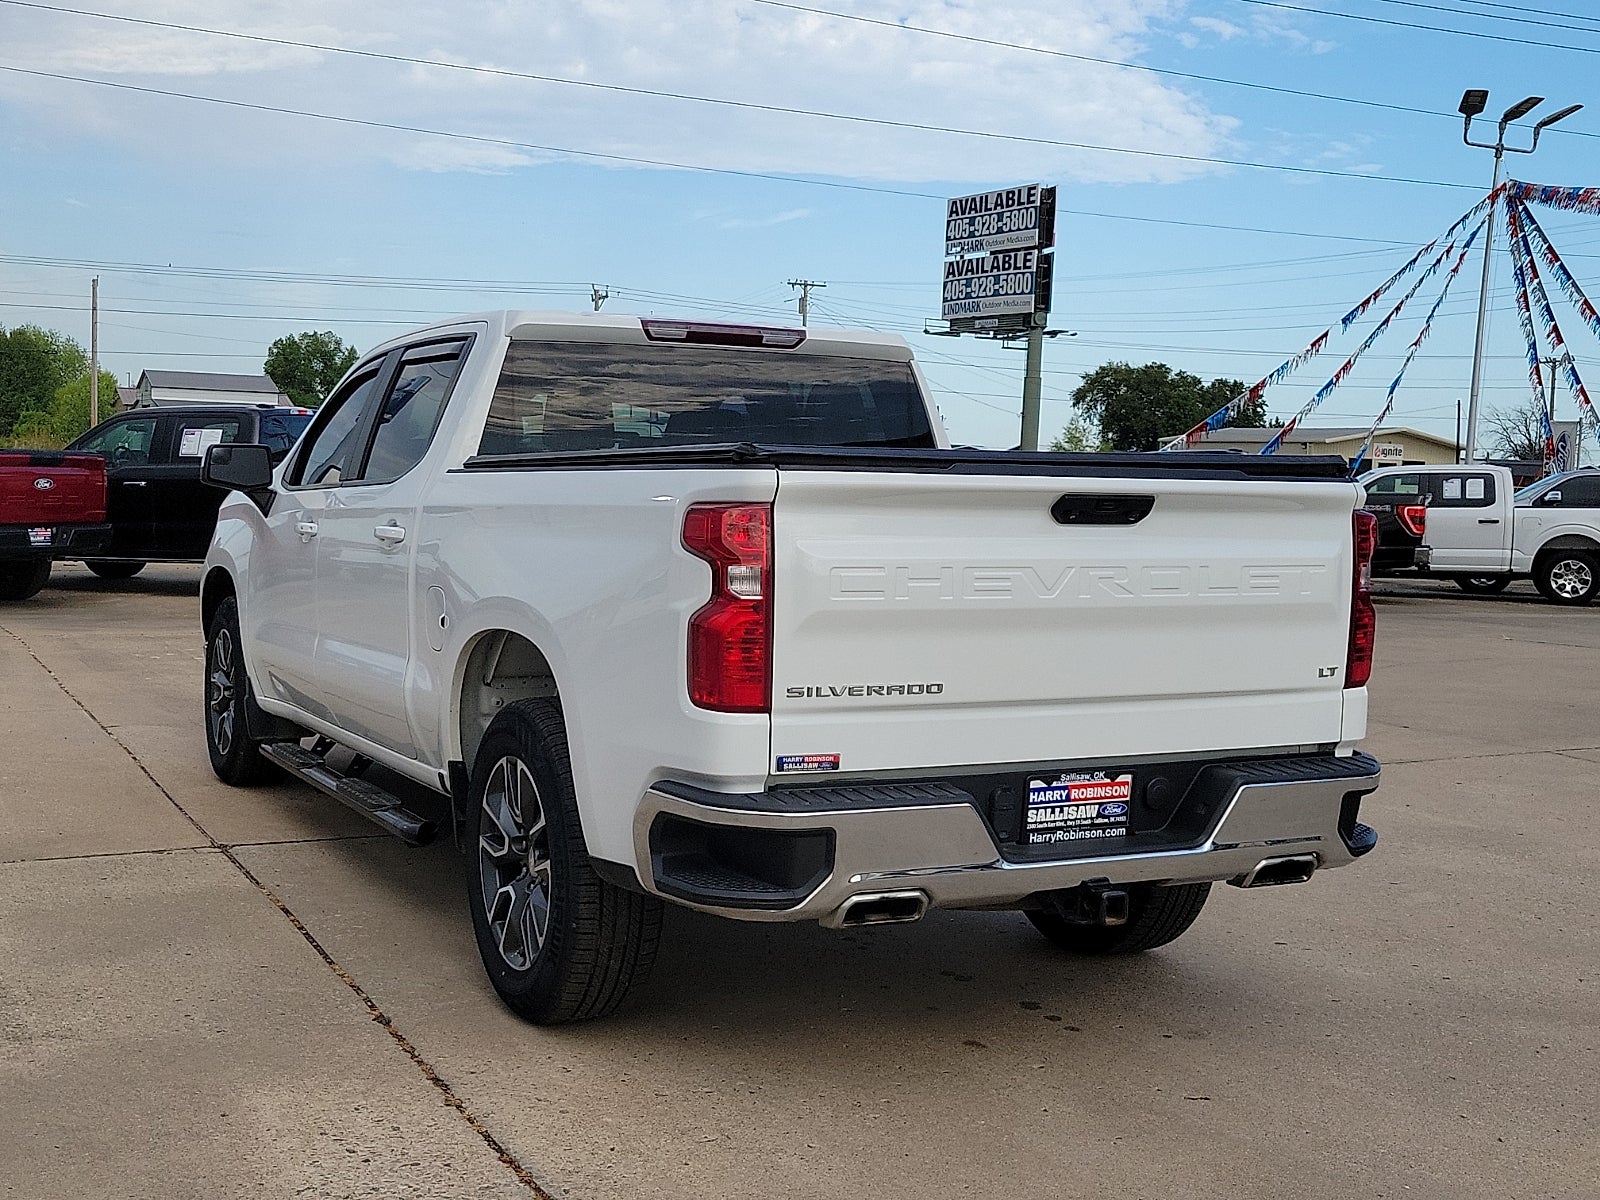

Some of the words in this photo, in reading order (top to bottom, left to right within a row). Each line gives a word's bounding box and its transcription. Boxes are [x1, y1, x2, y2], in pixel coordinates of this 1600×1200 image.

[948, 185, 1037, 218] AVAILABLE
[947, 208, 1035, 240] 405-928-5800
[985, 239, 1006, 248] Outdoor
[1006, 234, 1035, 244] Media.com
[945, 251, 1033, 279] AVAILABLE
[944, 272, 1031, 301] 405-928-5800
[943, 300, 982, 316] LINDMARK
[982, 301, 1002, 310] Outdoor
[1002, 297, 1031, 307] Media.com
[1381, 446, 1403, 458] ignite
[829, 564, 1327, 600] CHEVROLET
[1317, 666, 1338, 679] LT
[785, 683, 945, 699] SILVERADO
[1093, 770, 1106, 779] OK
[1029, 790, 1068, 803] HARRY
[1071, 785, 1129, 799] ROBINSON
[1027, 805, 1099, 823] SALLISAW
[1103, 804, 1124, 814] Ford
[1029, 827, 1126, 844] HarryRobinson.com
